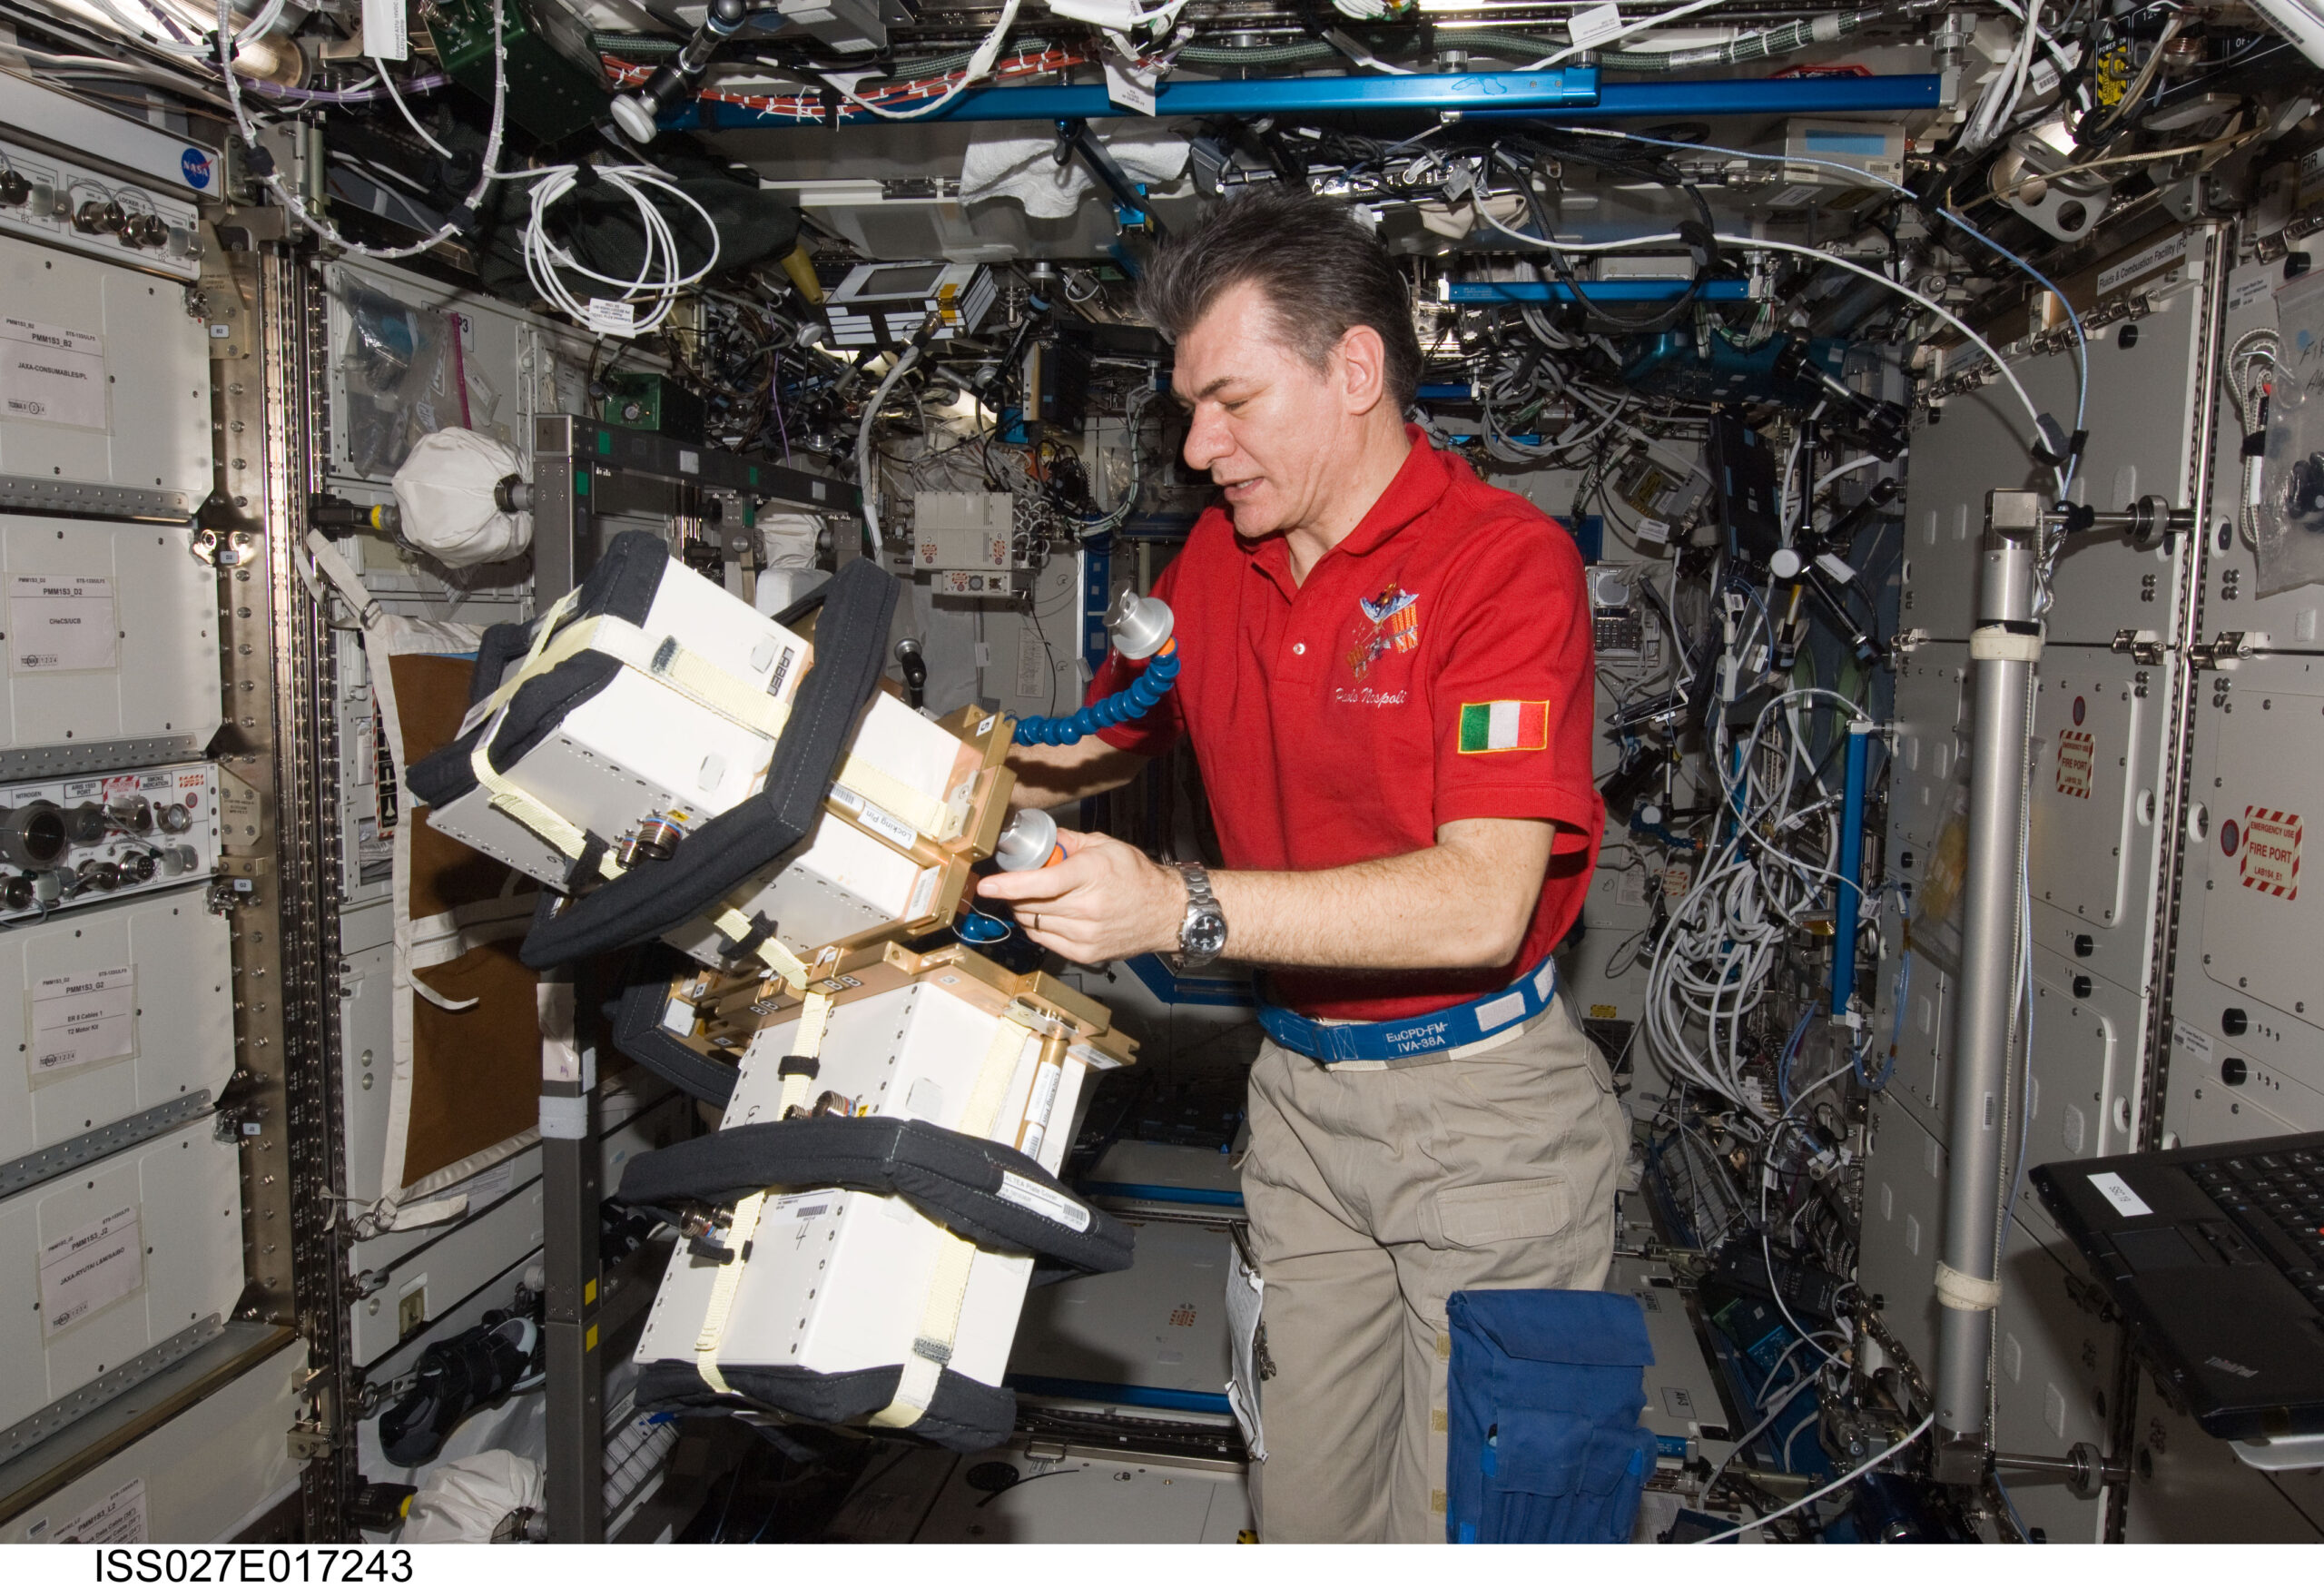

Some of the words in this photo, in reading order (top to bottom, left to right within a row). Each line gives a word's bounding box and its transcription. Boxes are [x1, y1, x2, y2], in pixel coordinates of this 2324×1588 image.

[2099, 41, 2117, 54] POWER
[2118, 36, 2127, 44] ON
[183, 159, 209, 177] NASA
[2120, 255, 2153, 280] Combustion
[2154, 244, 2176, 262] Facility
[32, 332, 72, 347] PMM1S3_B2
[18, 362, 87, 380] JAXA-CONSUMABLES/PL
[43, 588, 83, 597] PMM1S3_D2
[766, 646, 794, 697] LABEN
[2063, 757, 2073, 769] FIRE
[2073, 759, 2087, 771] PORT
[15, 791, 42, 799] NITROGEN
[866, 810, 879, 823] Pin
[879, 815, 912, 843] Locking
[2250, 821, 2282, 836] EMERGENCY
[2283, 828, 2294, 839] USE
[2250, 842, 2268, 857] FIRE
[2270, 846, 2292, 863] PORT
[65, 981, 104, 994] PMM1S3_G2
[823, 980, 842, 991] B
[842, 976, 861, 987] B
[750, 1006, 768, 1015] B
[760, 1001, 778, 1010] B
[81, 1011, 98, 1020] Cables
[1046, 1072, 1059, 1109] Locking
[1042, 1109, 1050, 1123] Pin
[1041, 1189, 1058, 1200] Cover
[72, 1228, 108, 1250] PMM1S3_J2
[60, 1263, 95, 1285] JAXA-RYUTAI
[78, 1503, 116, 1532] PMM1S3_L2
